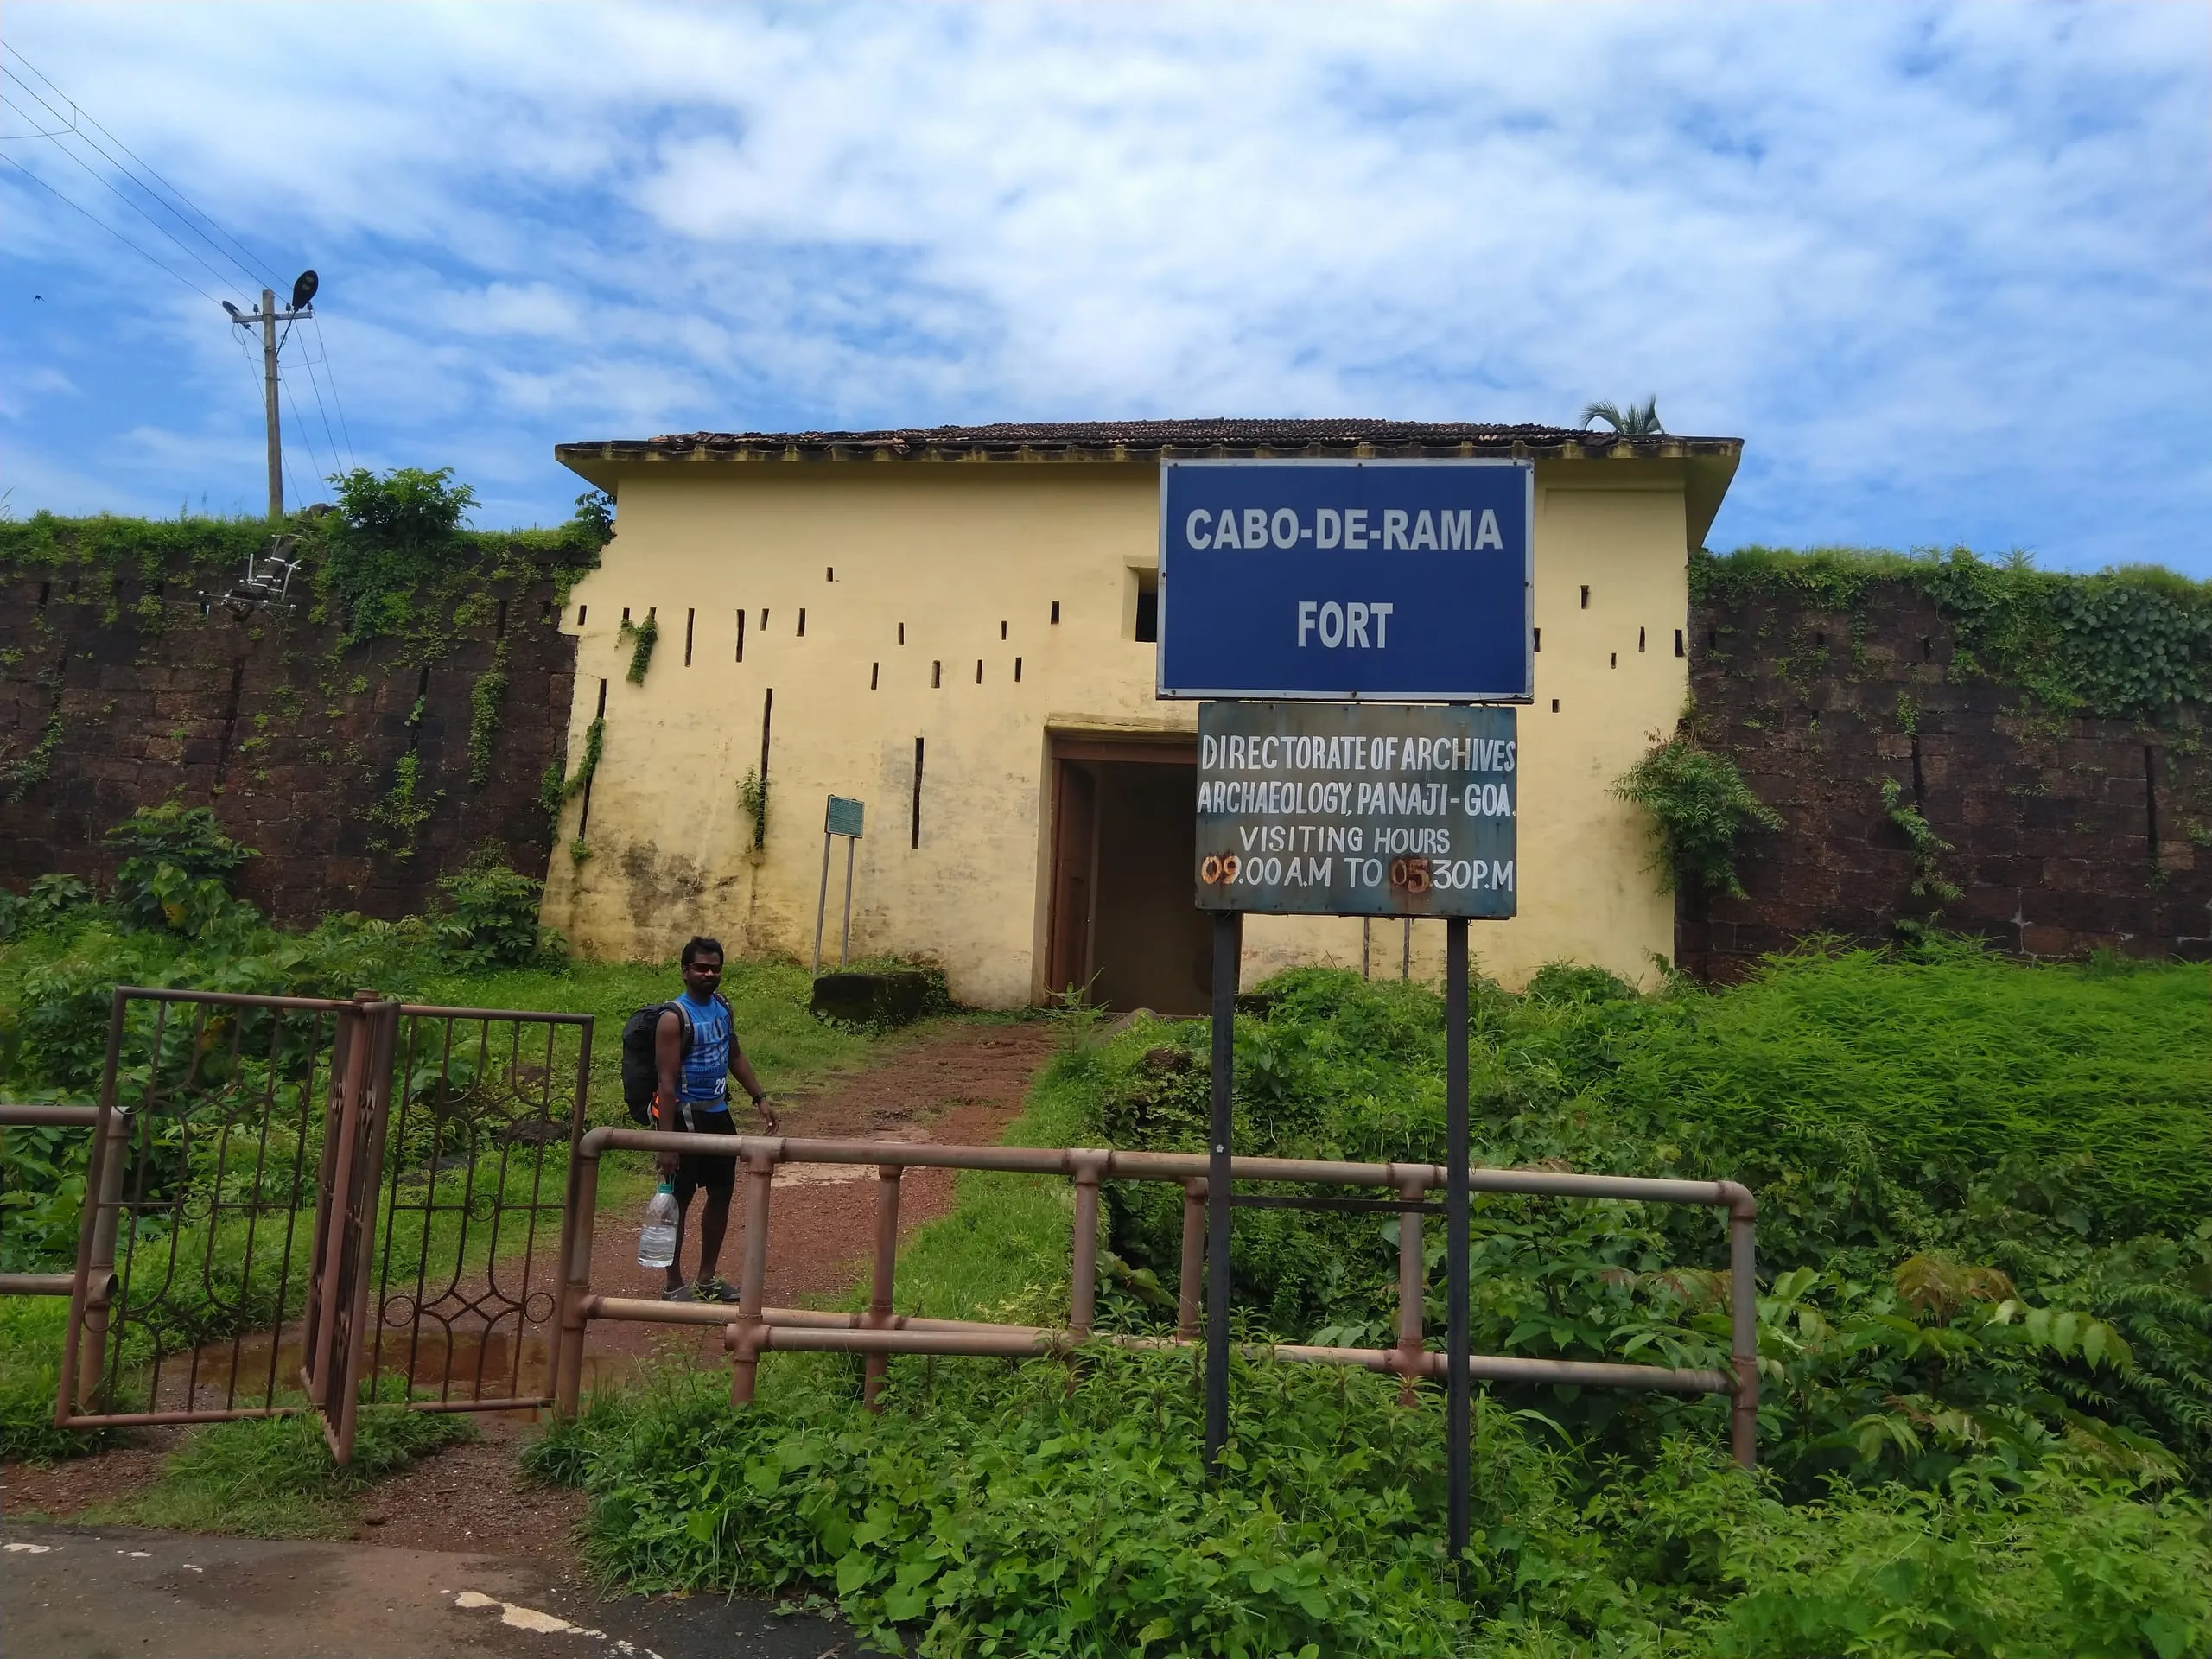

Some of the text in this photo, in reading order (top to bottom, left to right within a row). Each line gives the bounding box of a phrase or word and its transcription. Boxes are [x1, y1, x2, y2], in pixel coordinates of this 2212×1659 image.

[1186, 508, 1503, 550] CABO-DE-RAMA
[1297, 601, 1394, 649] FORT
[1202, 734, 1516, 772] DIRECTORATE OF ARCHIVES
[1197, 780, 1354, 817] ARCHAEOLOGY,
[1239, 825, 1451, 854] VISITING HOURS
[1344, 857, 1382, 888] TO
